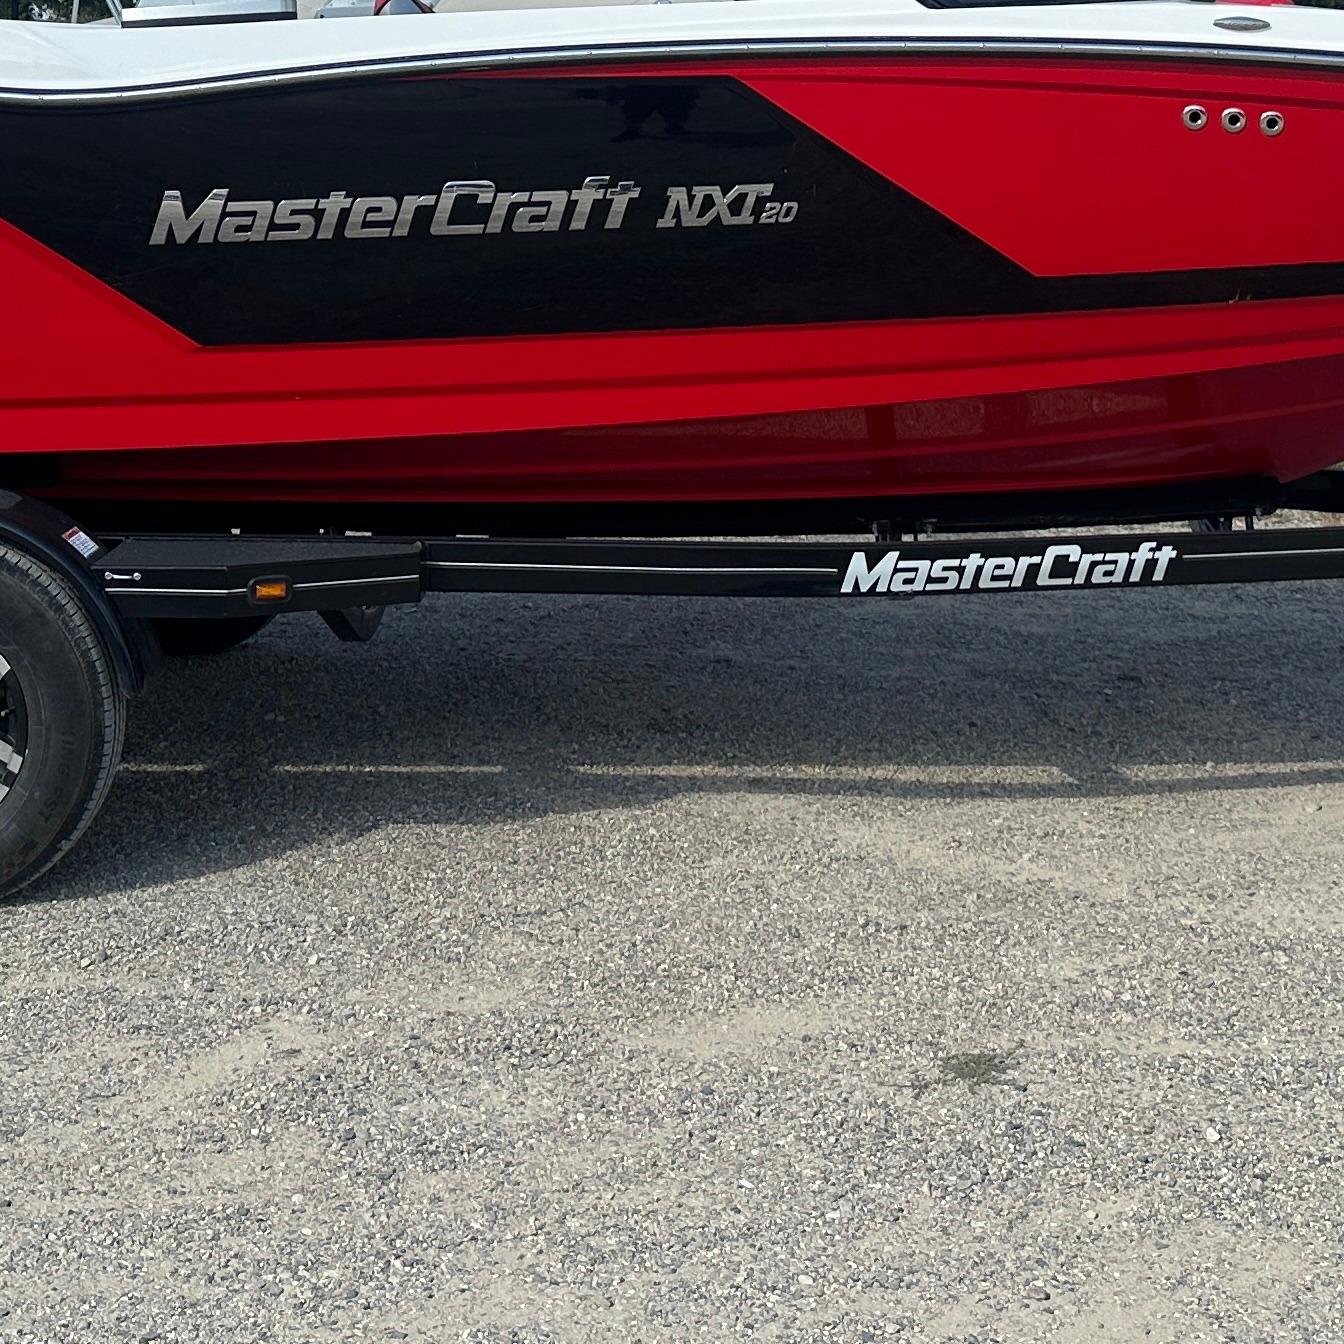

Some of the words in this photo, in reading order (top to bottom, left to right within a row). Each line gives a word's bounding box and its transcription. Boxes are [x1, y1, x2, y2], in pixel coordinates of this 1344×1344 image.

[148, 175, 641, 246] MasterCraft
[656, 183, 775, 228] NXT
[759, 201, 799, 225] 20
[840, 541, 1178, 594] MasterCraft
